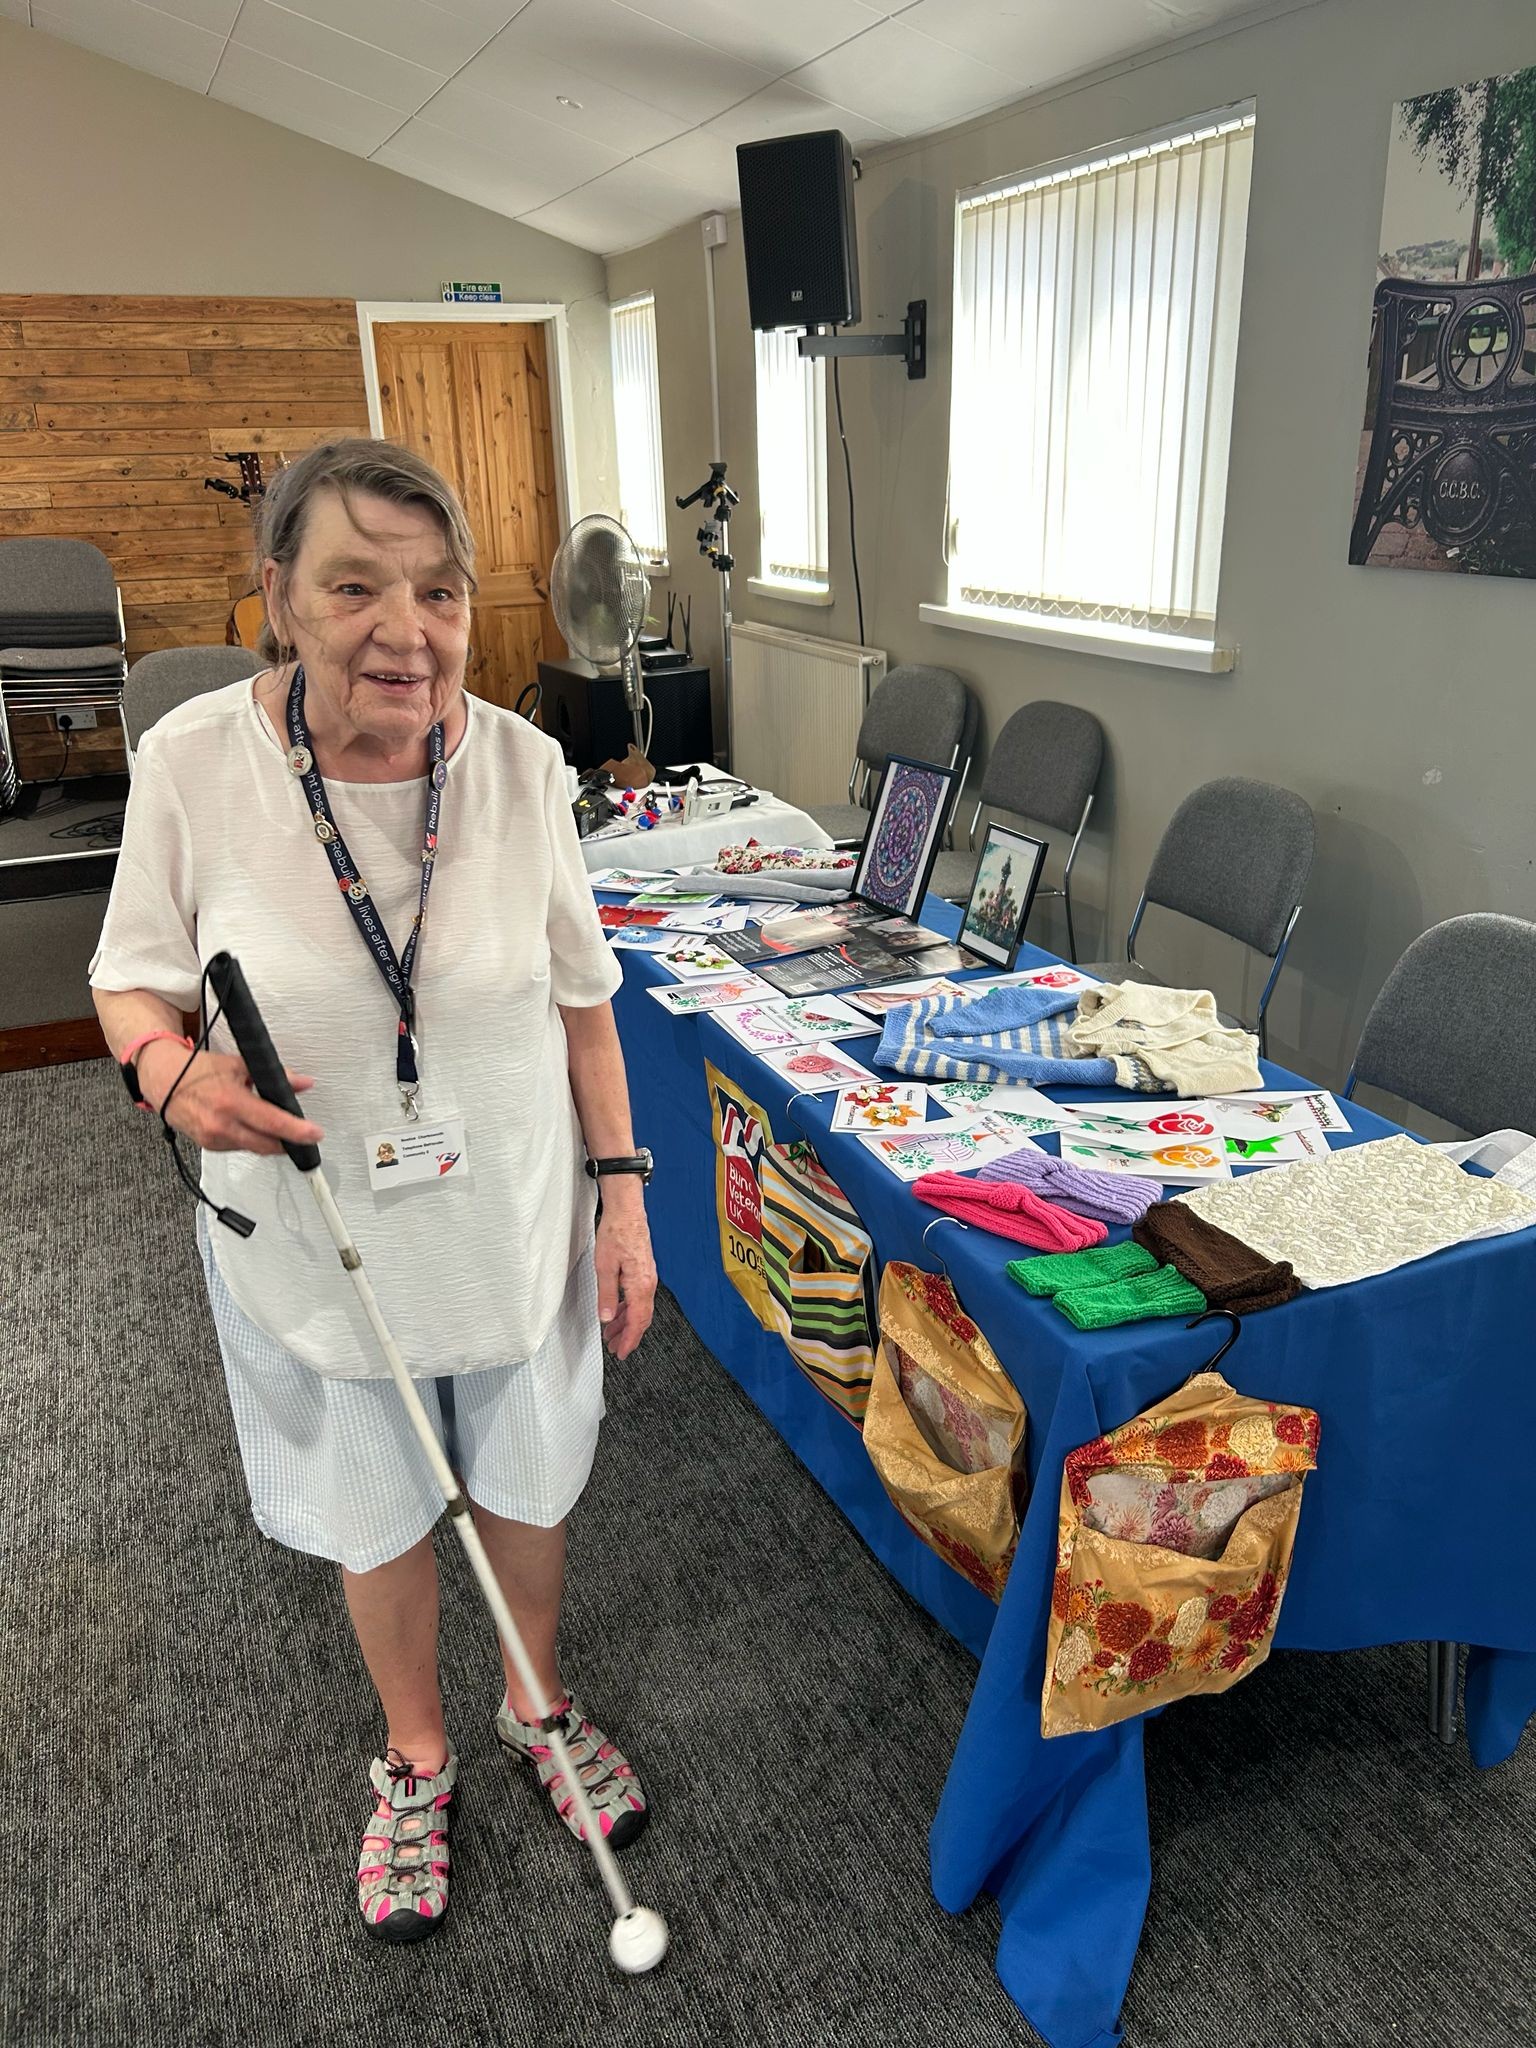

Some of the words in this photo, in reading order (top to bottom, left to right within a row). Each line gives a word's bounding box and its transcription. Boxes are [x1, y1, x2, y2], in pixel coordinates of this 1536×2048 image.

[459, 293, 478, 302] Keep
[461, 284, 476, 292] Fire
[478, 284, 493, 292] exit
[440, 481, 480, 499] C.C.B.C.
[358, 904, 377, 933] lives
[371, 932, 391, 962] after
[730, 1201, 744, 1224] UK
[729, 1235, 757, 1270] 100
